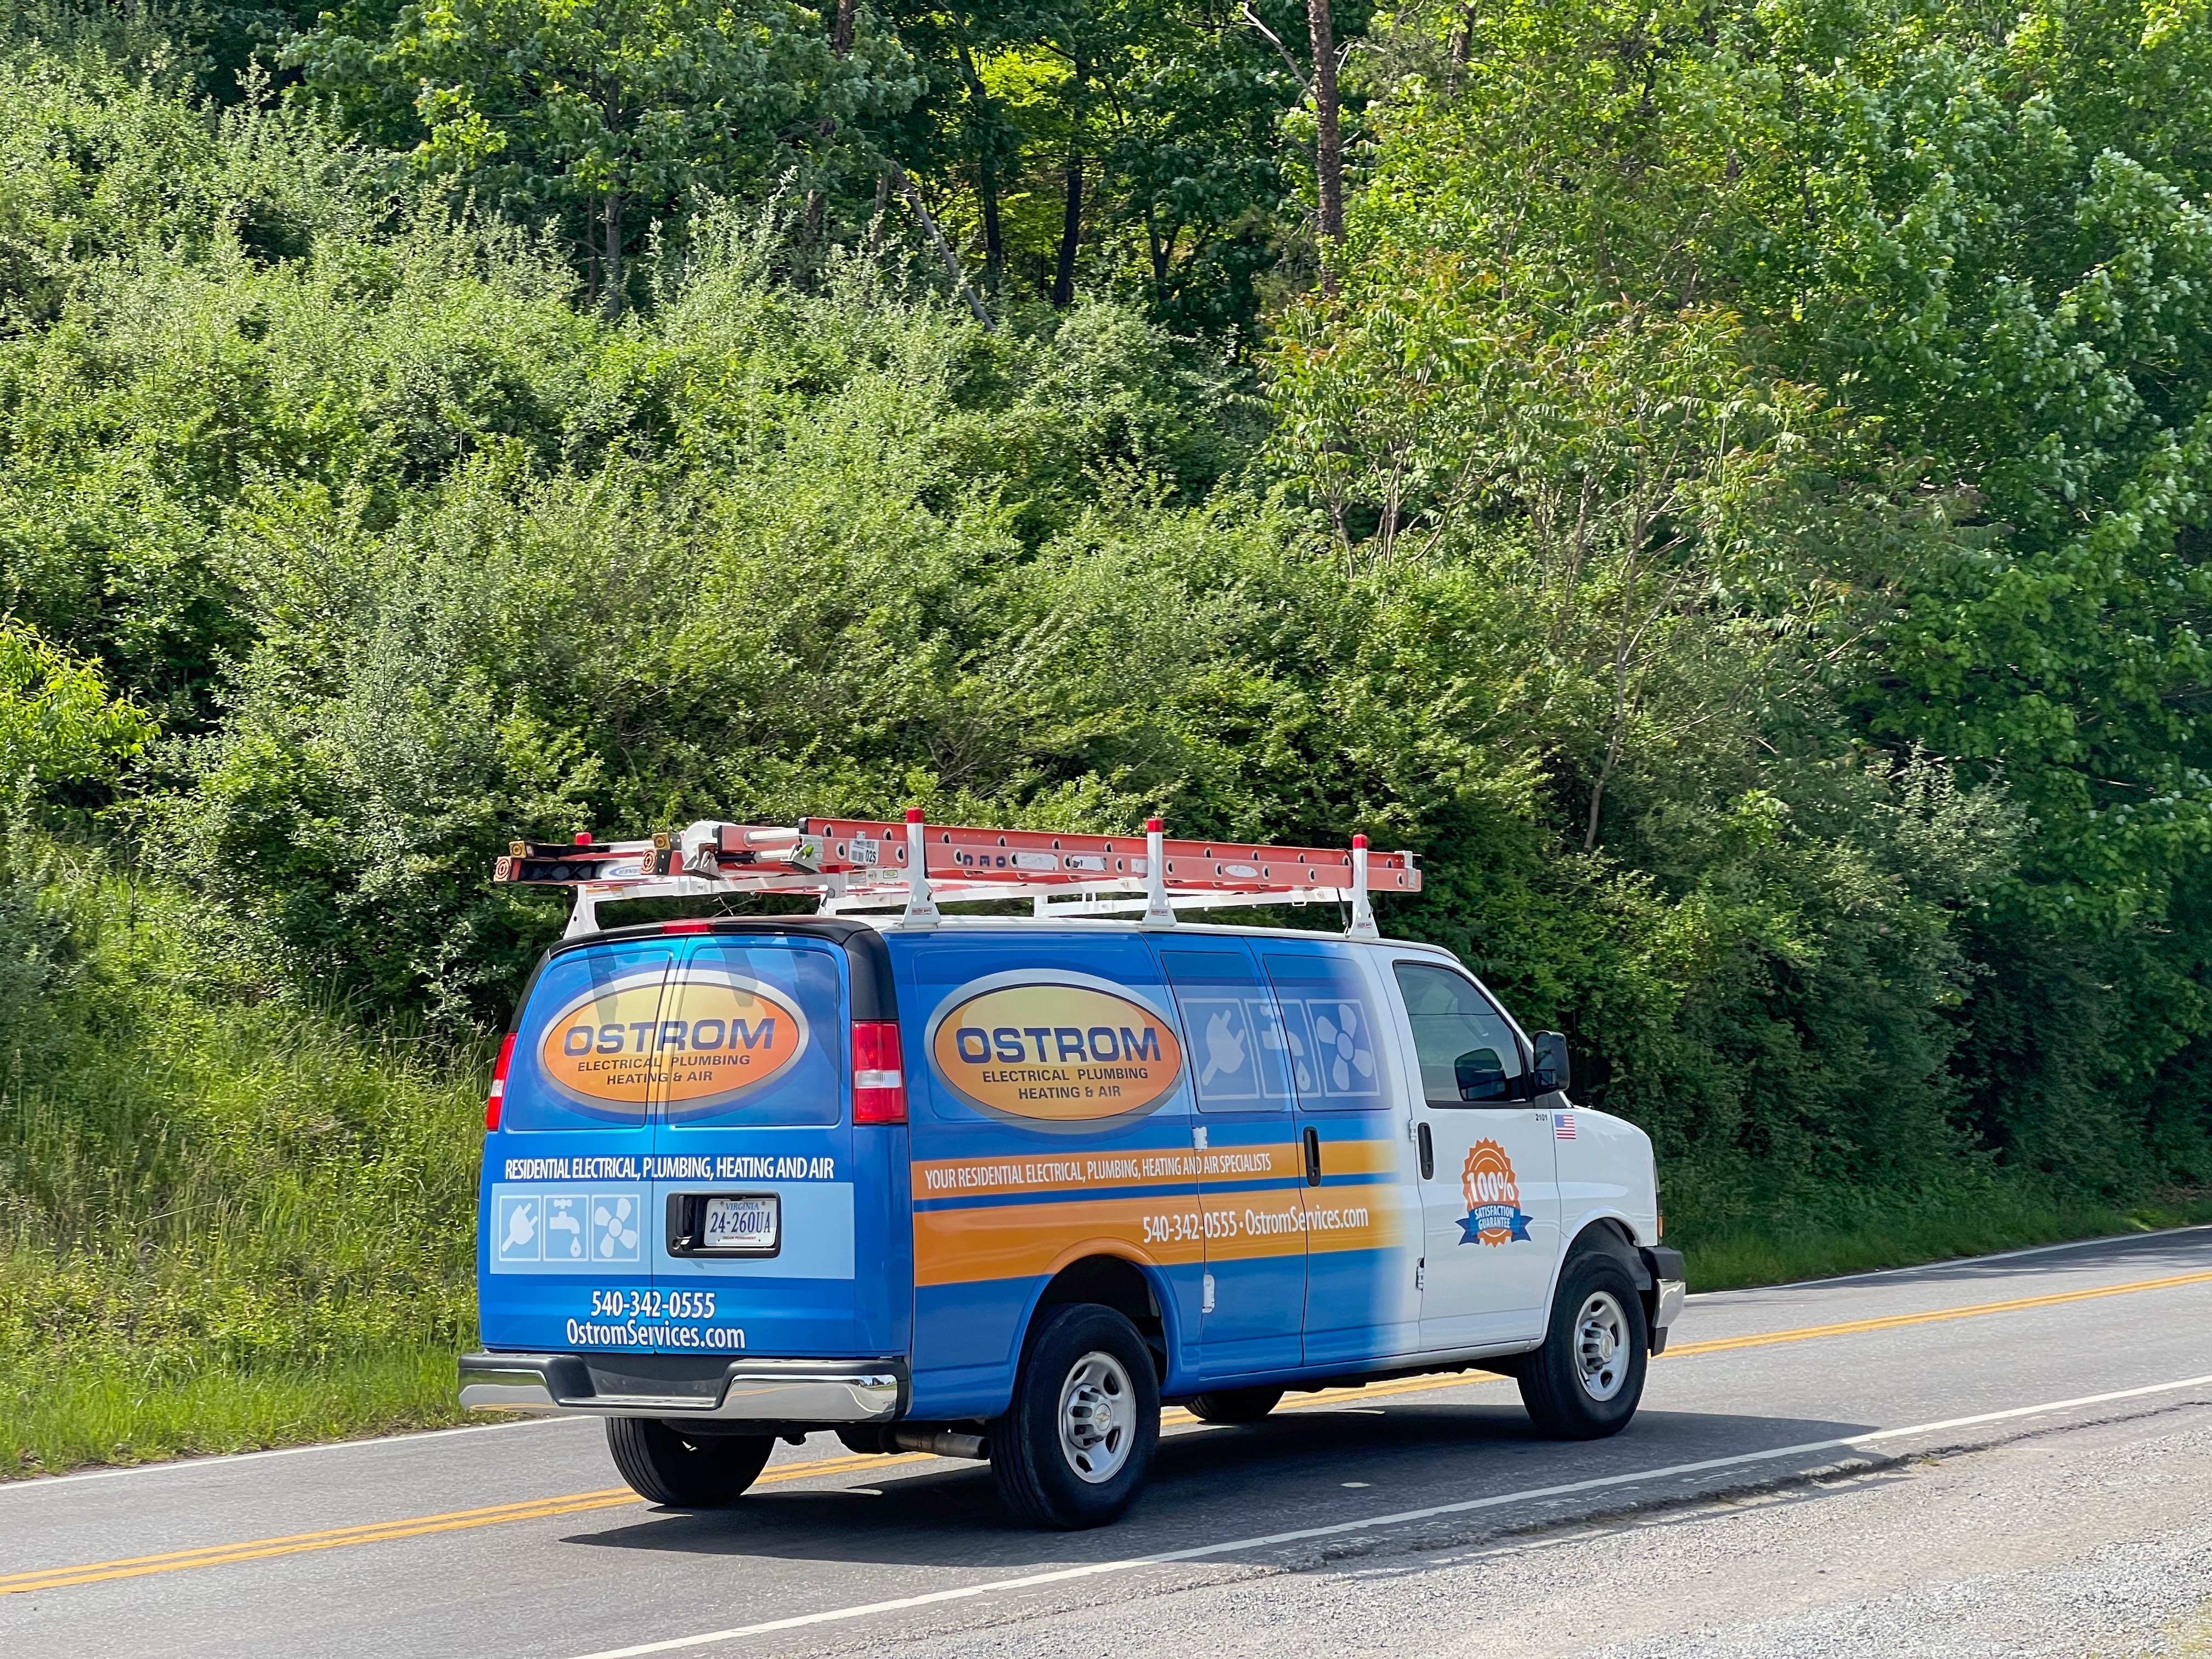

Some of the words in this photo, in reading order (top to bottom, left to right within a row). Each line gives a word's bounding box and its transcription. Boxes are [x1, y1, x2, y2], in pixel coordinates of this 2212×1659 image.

[564, 1018, 775, 1057] OSTROM
[956, 1026, 1161, 1064] OSTROM
[578, 1058, 662, 1072] ELECTRICAL
[671, 1054, 751, 1066] PLUMBING
[607, 1073, 668, 1085] HEATING
[674, 1072, 682, 1082] &
[687, 1071, 713, 1081] AIR
[983, 1069, 1070, 1083] ELECTRICAL
[1077, 1068, 1148, 1080] PLUMBING
[1018, 1087, 1080, 1099] HEATING
[1085, 1087, 1093, 1097] &
[1098, 1086, 1121, 1098] AIR
[505, 1159, 572, 1180] RESIDENTIAL
[572, 1157, 640, 1181] ELECTRICAL,
[642, 1156, 714, 1181] PLUMBING,
[716, 1156, 774, 1179] HEATING
[775, 1157, 808, 1179] AND
[809, 1157, 834, 1180] AIR
[925, 1169, 957, 1190] YOUR
[958, 1165, 1025, 1187] RESIDENTIAL
[1025, 1161, 1086, 1183] ELECTRICAL,
[1087, 1159, 1141, 1180] PLUMBING,
[1142, 1157, 1182, 1177] HEATING
[1183, 1156, 1201, 1175] AND
[1204, 1155, 1220, 1173] AIR
[1220, 1153, 1272, 1173] SPECIALISTS
[1467, 1171, 1515, 1203] 100%
[725, 1202, 759, 1210] VIRGINIA
[1474, 1205, 1514, 1220] SATISFACTION
[709, 1211, 771, 1233] 24-260UA
[1143, 1211, 1237, 1243] 540-342-0555
[1245, 1205, 1369, 1235] OstromServices.com
[1479, 1216, 1510, 1230] GUARANTEE
[591, 1290, 715, 1318] 540-342-0555
[567, 1318, 746, 1349] OstromServices.com
